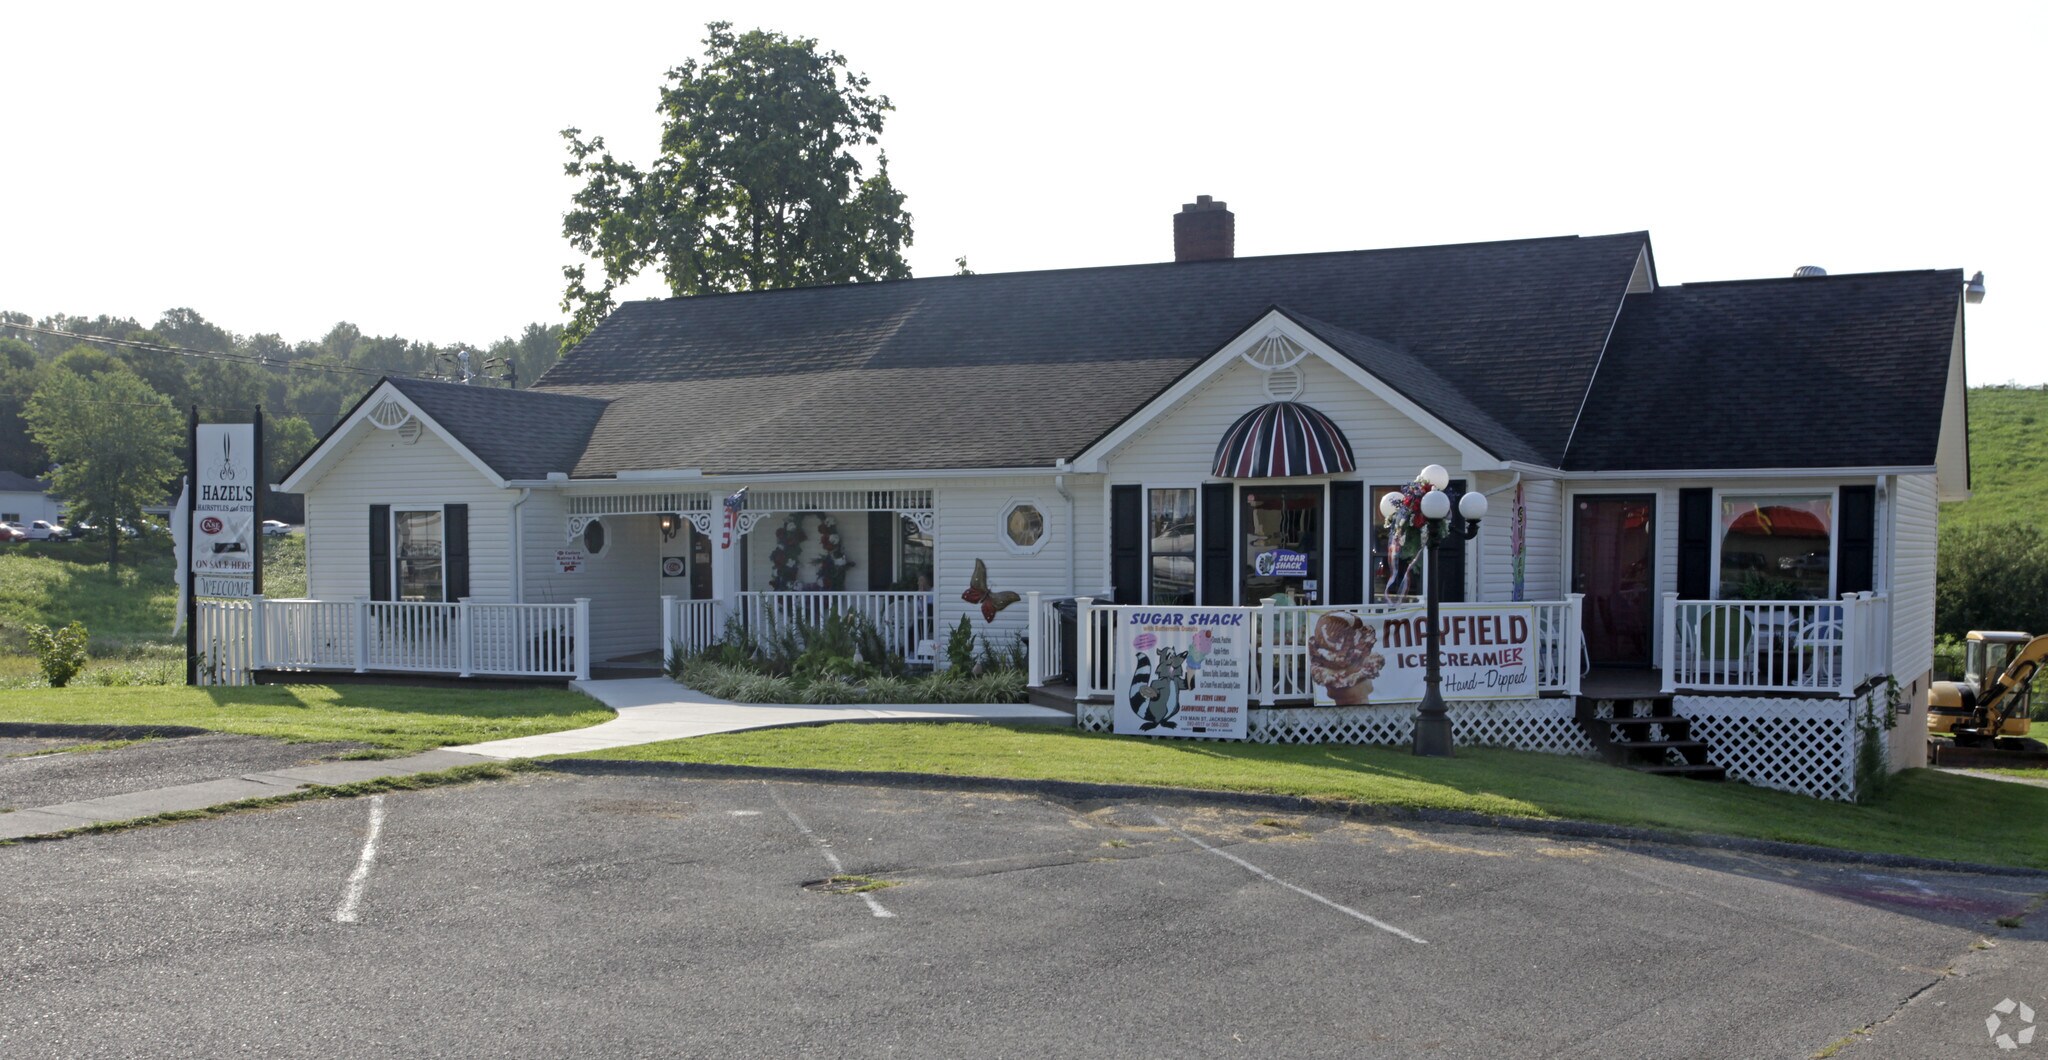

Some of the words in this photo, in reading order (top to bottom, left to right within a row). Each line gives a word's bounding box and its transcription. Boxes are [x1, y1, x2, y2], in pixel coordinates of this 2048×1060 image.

[202, 485, 253, 501] HAZEL'S
[196, 560, 207, 568] ON
[210, 560, 229, 569] SALE
[231, 561, 252, 569] HERE
[1279, 554, 1306, 562] SUGAR
[1275, 562, 1302, 570] SHACK
[201, 578, 250, 596] WELCOME
[1130, 613, 1184, 625] SUGAR
[1189, 613, 1243, 626] SHACK
[1383, 615, 1528, 648] MAYFIELD
[1397, 653, 1428, 668] ICE
[1445, 666, 1528, 692] Hand-Dipped
